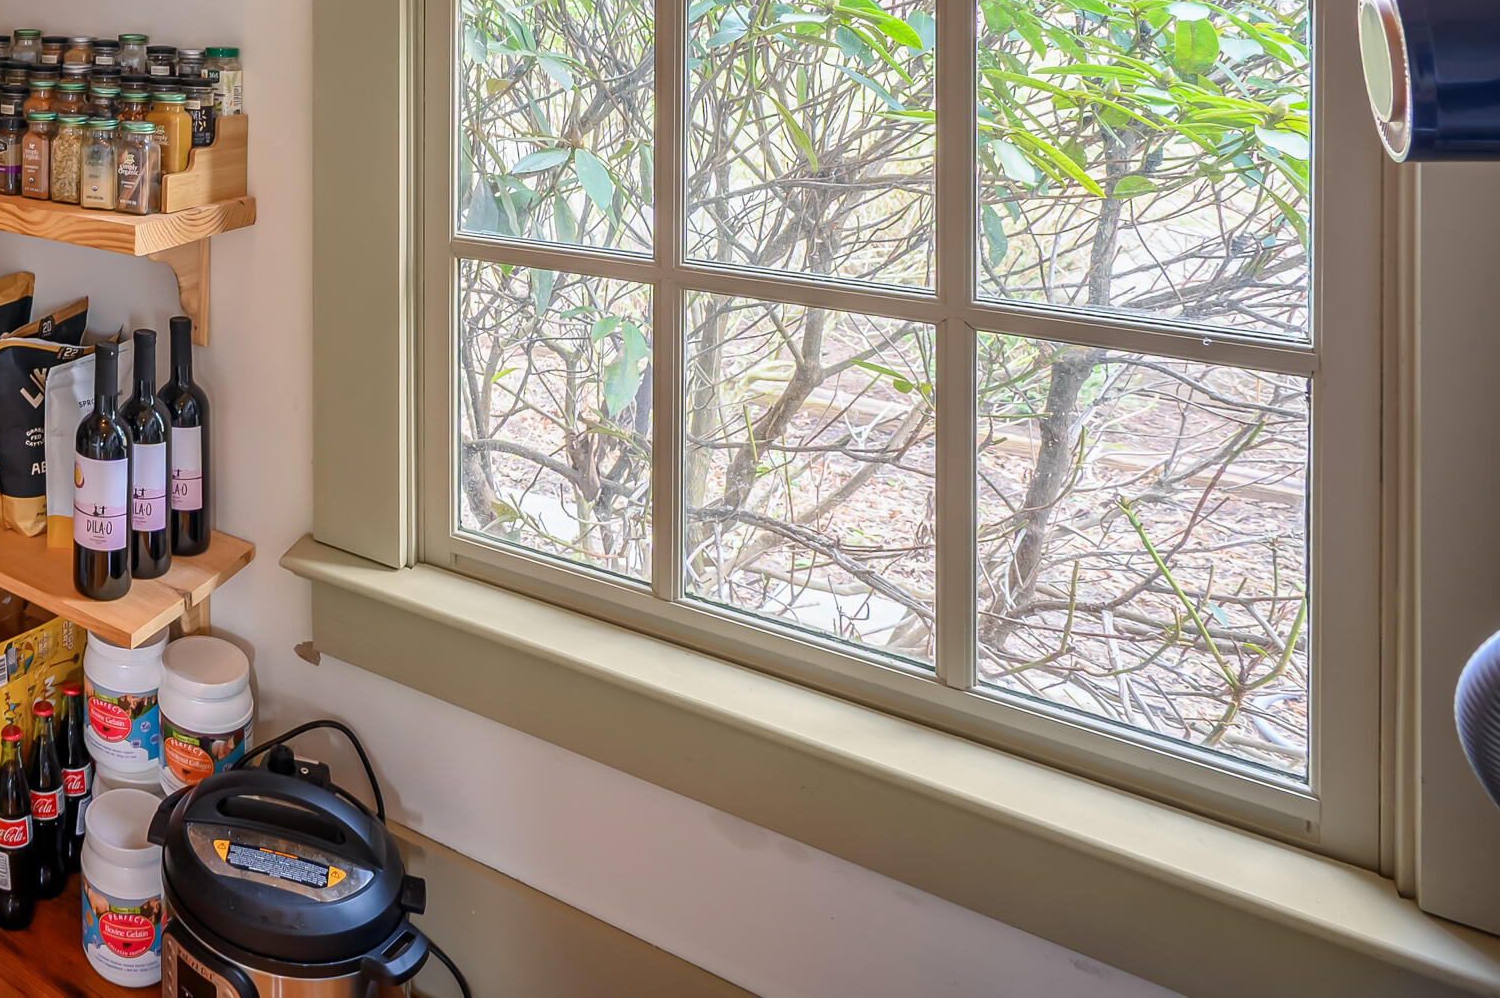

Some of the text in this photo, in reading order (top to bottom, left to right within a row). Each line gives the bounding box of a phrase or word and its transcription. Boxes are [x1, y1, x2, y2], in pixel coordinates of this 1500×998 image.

[119, 163, 138, 172] Simply
[108, 913, 145, 925] PERFECT
[105, 926, 149, 939] Bovine Gelatin
